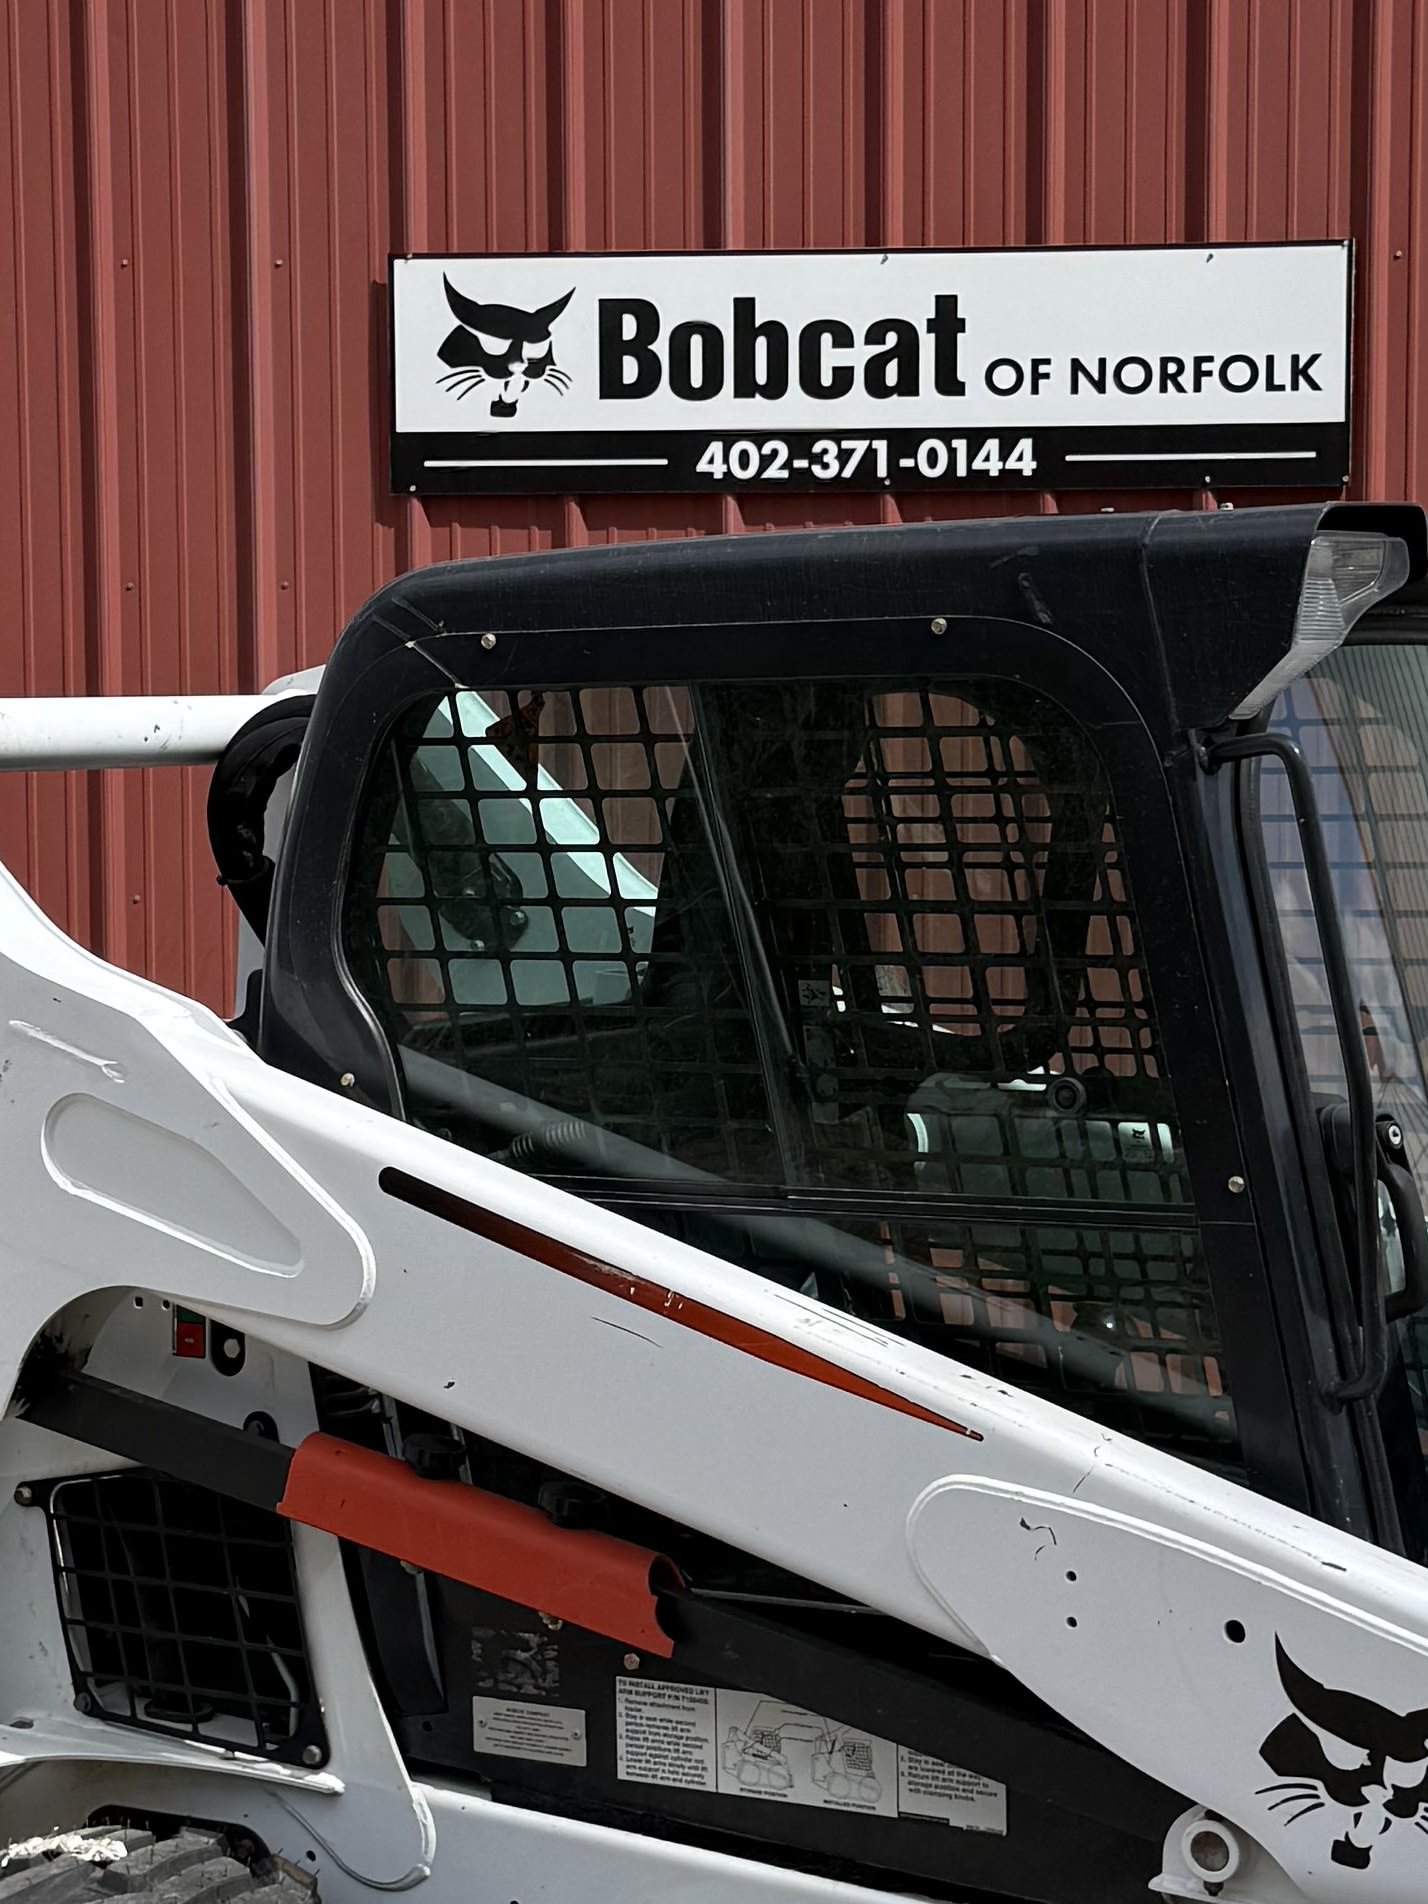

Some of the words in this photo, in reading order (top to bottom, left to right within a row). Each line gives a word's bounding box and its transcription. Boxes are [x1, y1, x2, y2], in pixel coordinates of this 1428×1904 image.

[598, 294, 966, 401] Bobcat
[984, 357, 1052, 396] OF
[1070, 352, 1323, 395] NORFOLK
[695, 437, 1037, 480] 402-371-0144
